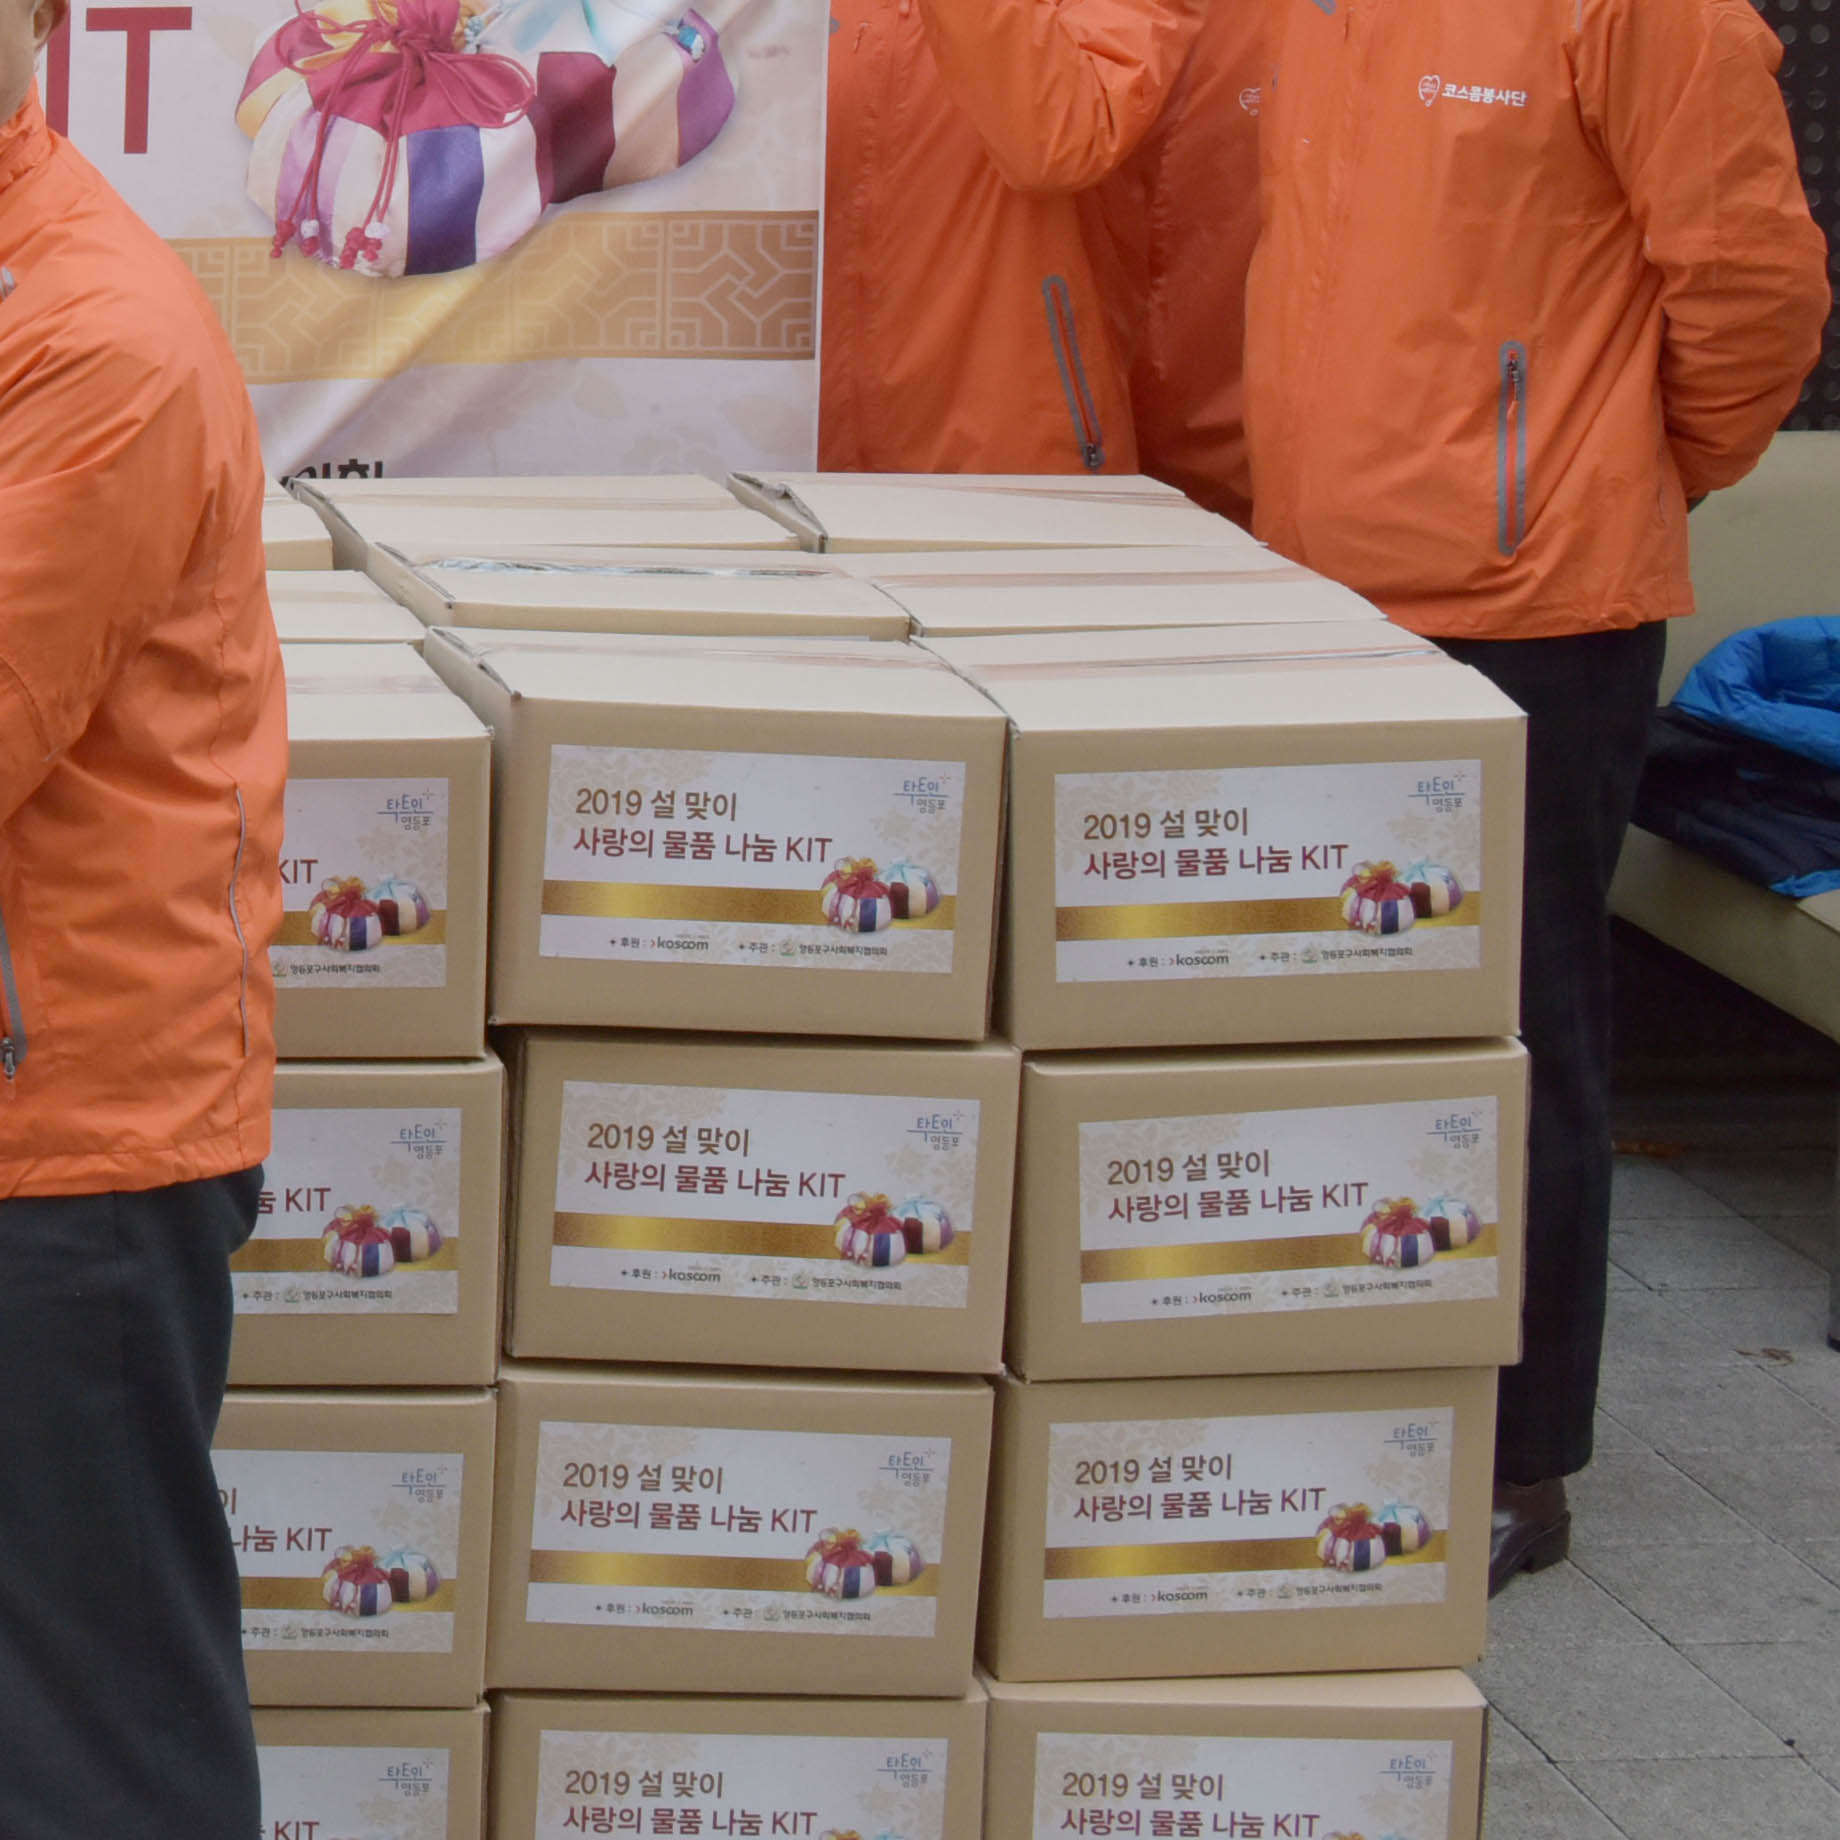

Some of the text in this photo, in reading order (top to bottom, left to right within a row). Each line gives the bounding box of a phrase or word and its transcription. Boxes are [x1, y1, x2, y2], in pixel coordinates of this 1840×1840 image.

[1442, 83, 1528, 108] 코스콤봉사단
[575, 787, 737, 822] 2019 설 맞이
[1083, 807, 1248, 841] 2019 설 맞이
[573, 826, 833, 863] 사랑의 물품 나눔 KIT
[1084, 844, 1349, 881] 사랑의 물품 나눔 KIT
[1107, 1149, 1269, 1186] 2019 설 맞이
[1108, 1182, 1369, 1224] 사랑의 물품 나눔 KIT
[562, 1462, 723, 1495] 2019 설 맞이
[1075, 1453, 1232, 1485] 2019 설 맞이
[560, 1498, 818, 1534] 사랑의 물품 나눔 KIT
[1073, 1487, 1327, 1523] 사랑의 물품 나눔 KIT
